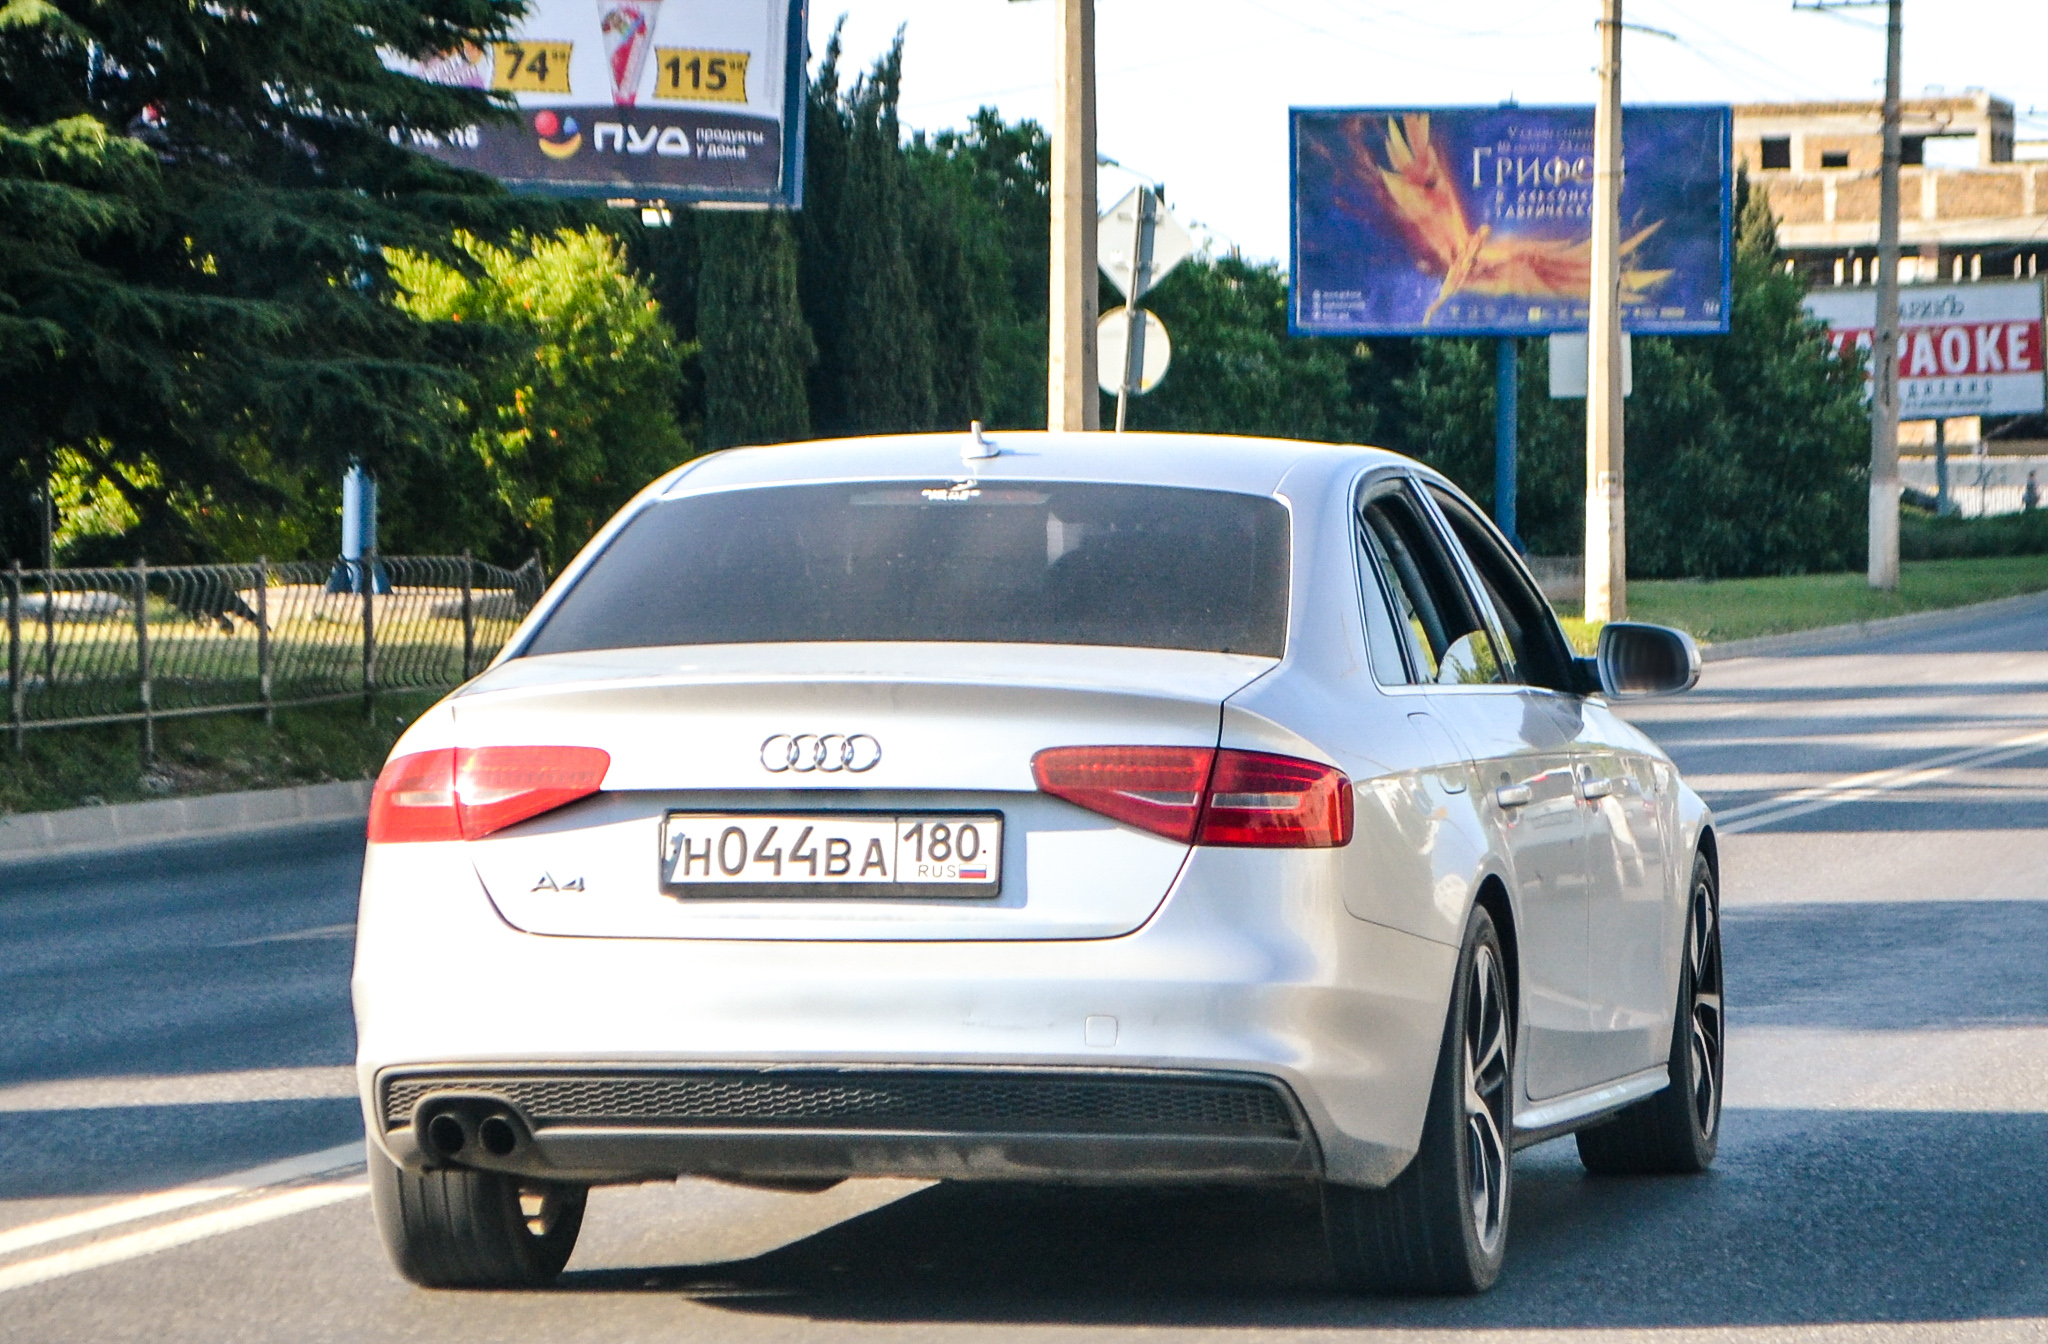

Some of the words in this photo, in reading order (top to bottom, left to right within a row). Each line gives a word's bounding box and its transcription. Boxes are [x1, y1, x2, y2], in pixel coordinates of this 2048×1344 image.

[504, 49, 549, 82] 74
[665, 55, 728, 91] 115
[593, 121, 690, 156] ПУД
[1472, 146, 1625, 188] ГРИФО
[1826, 322, 2031, 378] АОКЕ
[683, 825, 888, 877] Н044ВА
[902, 822, 980, 863] 180
[530, 871, 585, 893] A4
[917, 864, 957, 878] RUS
